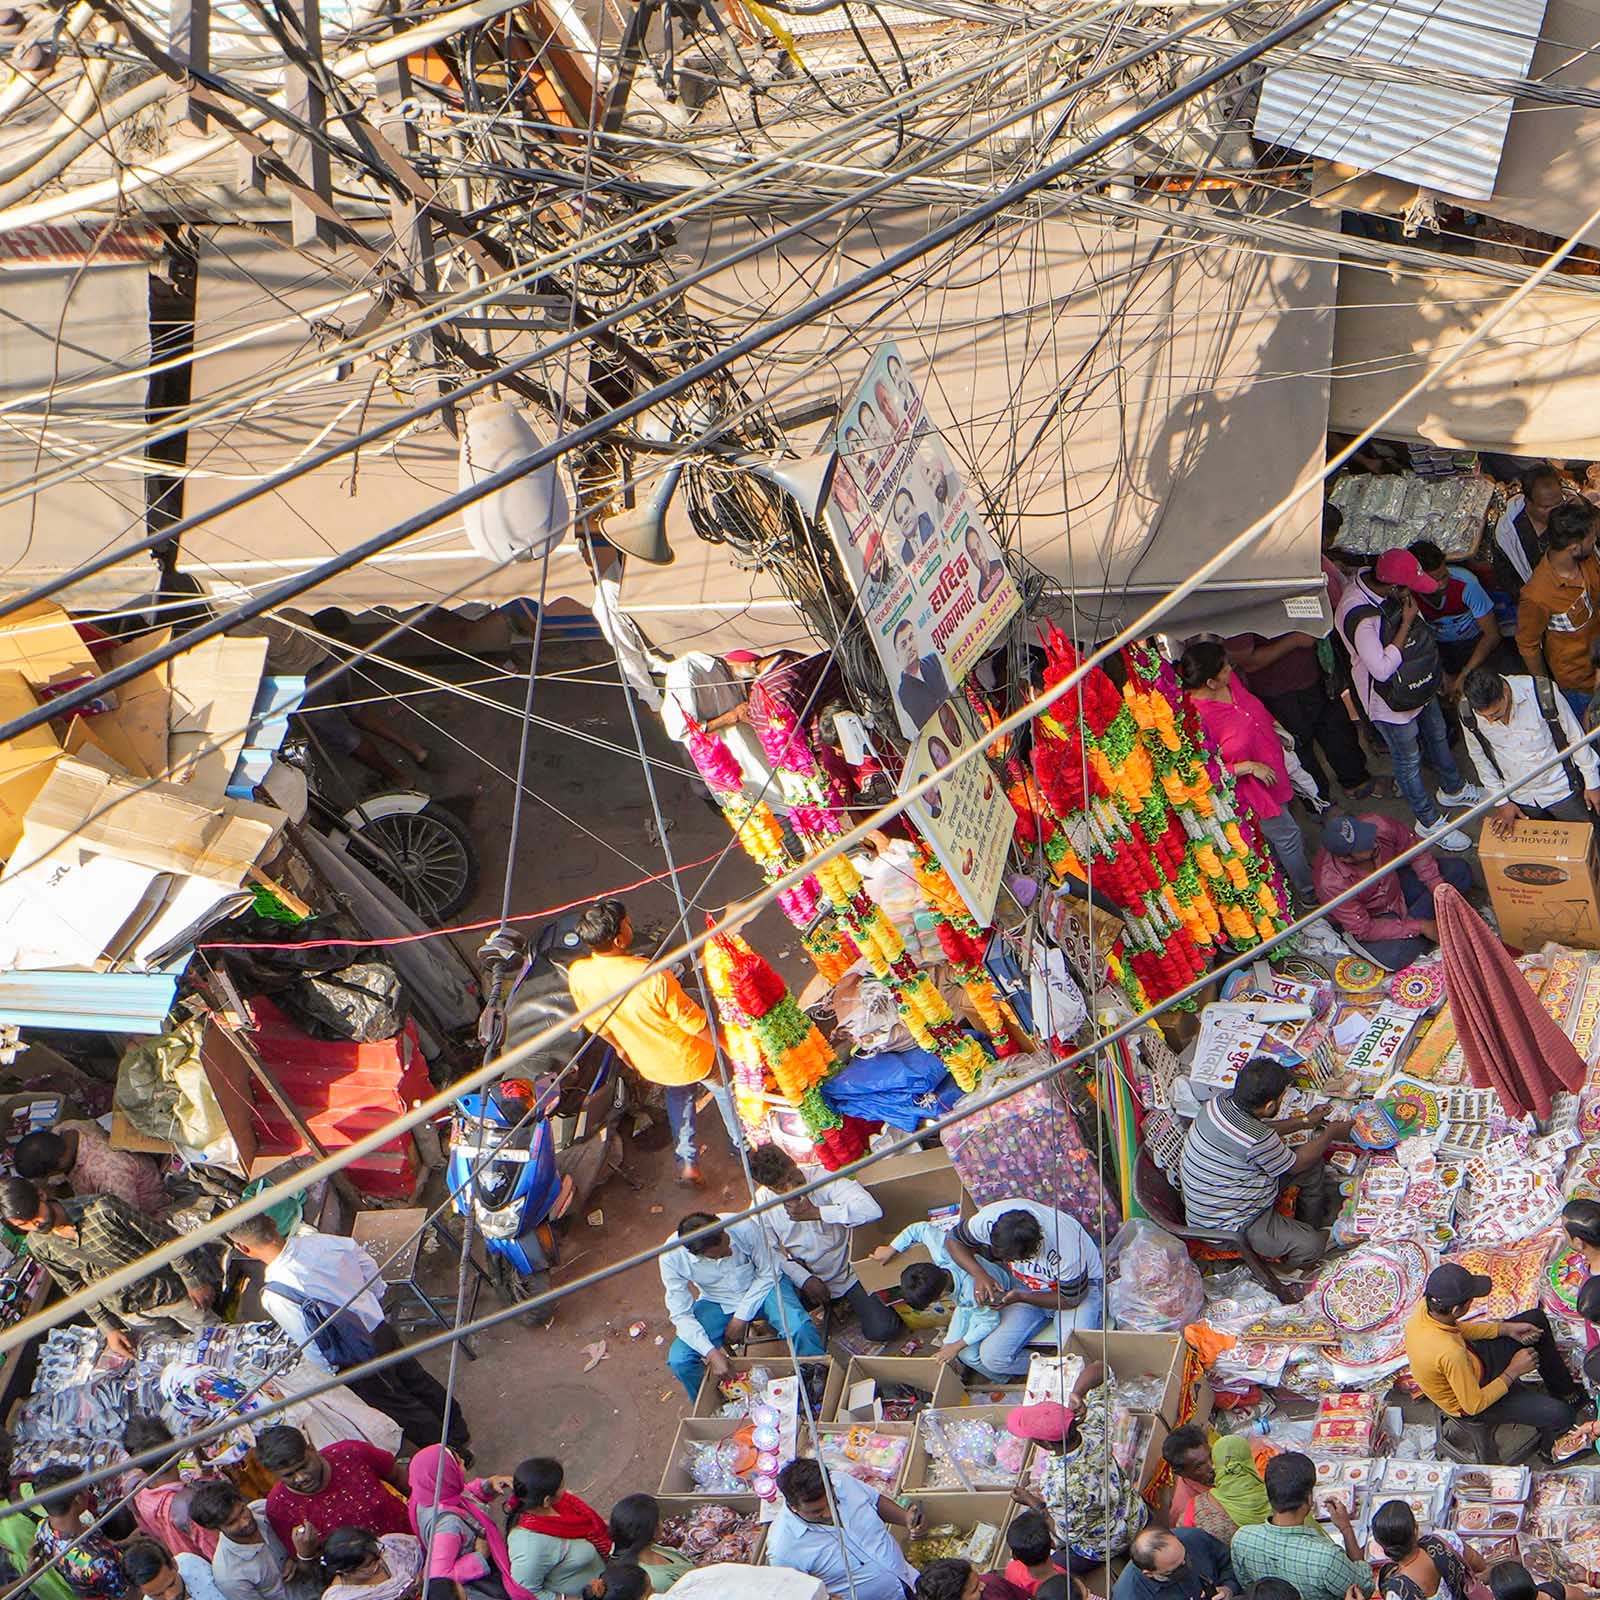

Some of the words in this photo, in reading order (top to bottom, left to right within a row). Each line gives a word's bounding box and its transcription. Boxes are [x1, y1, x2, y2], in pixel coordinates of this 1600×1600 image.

[928, 552, 971, 614] हार्दिक
[1348, 1015, 1394, 1069] दीपावली
[1379, 1034, 1403, 1059] शुभ
